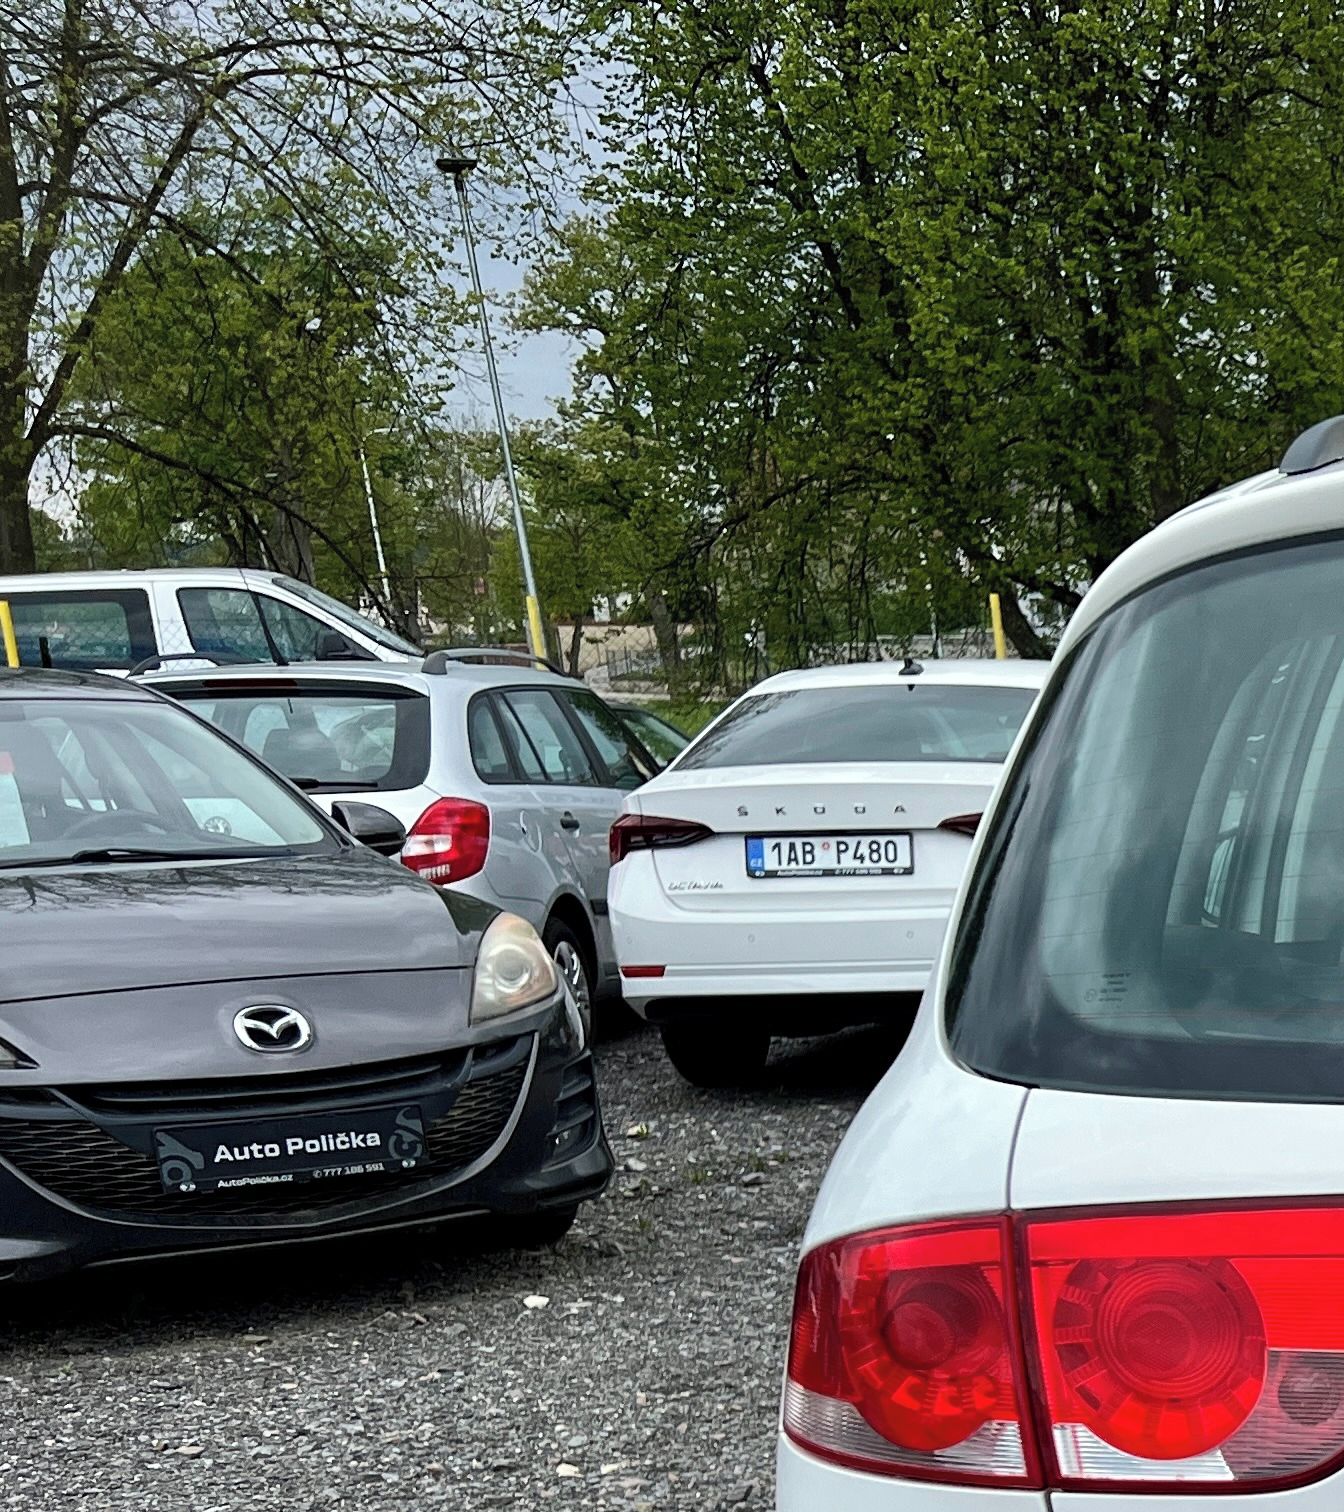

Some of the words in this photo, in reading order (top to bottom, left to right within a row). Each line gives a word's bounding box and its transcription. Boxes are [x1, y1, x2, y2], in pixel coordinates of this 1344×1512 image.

[771, 841, 816, 866] 1AB
[835, 839, 898, 865] P480
[213, 1142, 280, 1163] Auto
[285, 1131, 381, 1156] Polička
[322, 1167, 342, 1177] 777
[365, 1162, 385, 1173] 591
[217, 1174, 294, 1188] AutoPolička.cz
